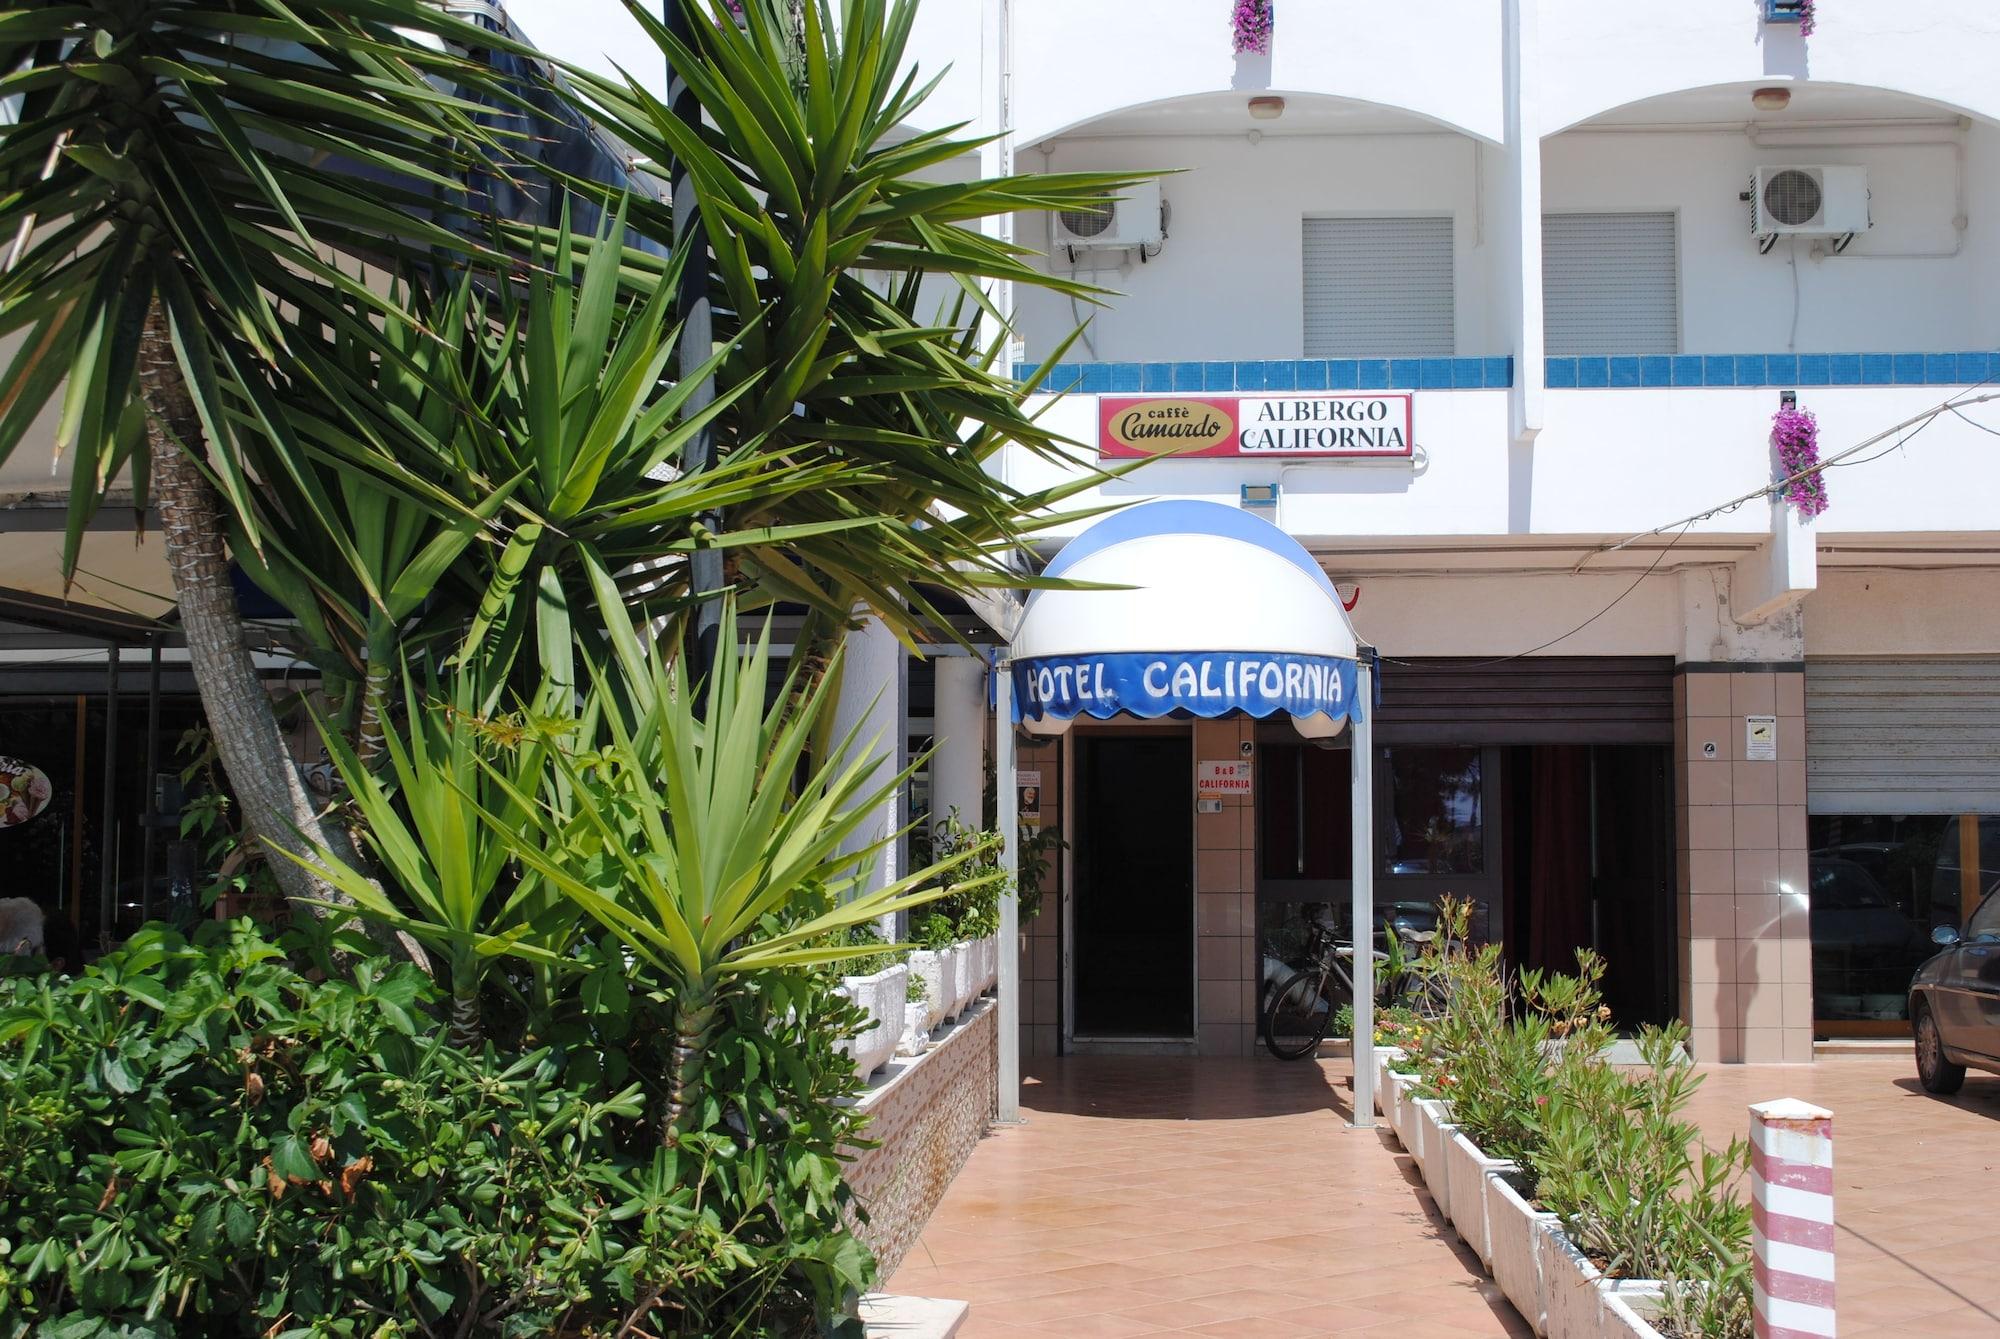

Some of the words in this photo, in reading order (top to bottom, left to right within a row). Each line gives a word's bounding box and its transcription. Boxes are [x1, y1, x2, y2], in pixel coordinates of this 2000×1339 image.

[1147, 407, 1190, 419] caffè
[1257, 400, 1388, 422] ALBERGO
[1120, 411, 1221, 442] Camardo
[1239, 426, 1406, 450] CALIFORNIA
[1027, 662, 1114, 703] HOTEL
[1142, 660, 1343, 703] CALIFORNIA
[1199, 780, 1250, 789] CALIFORNIA
